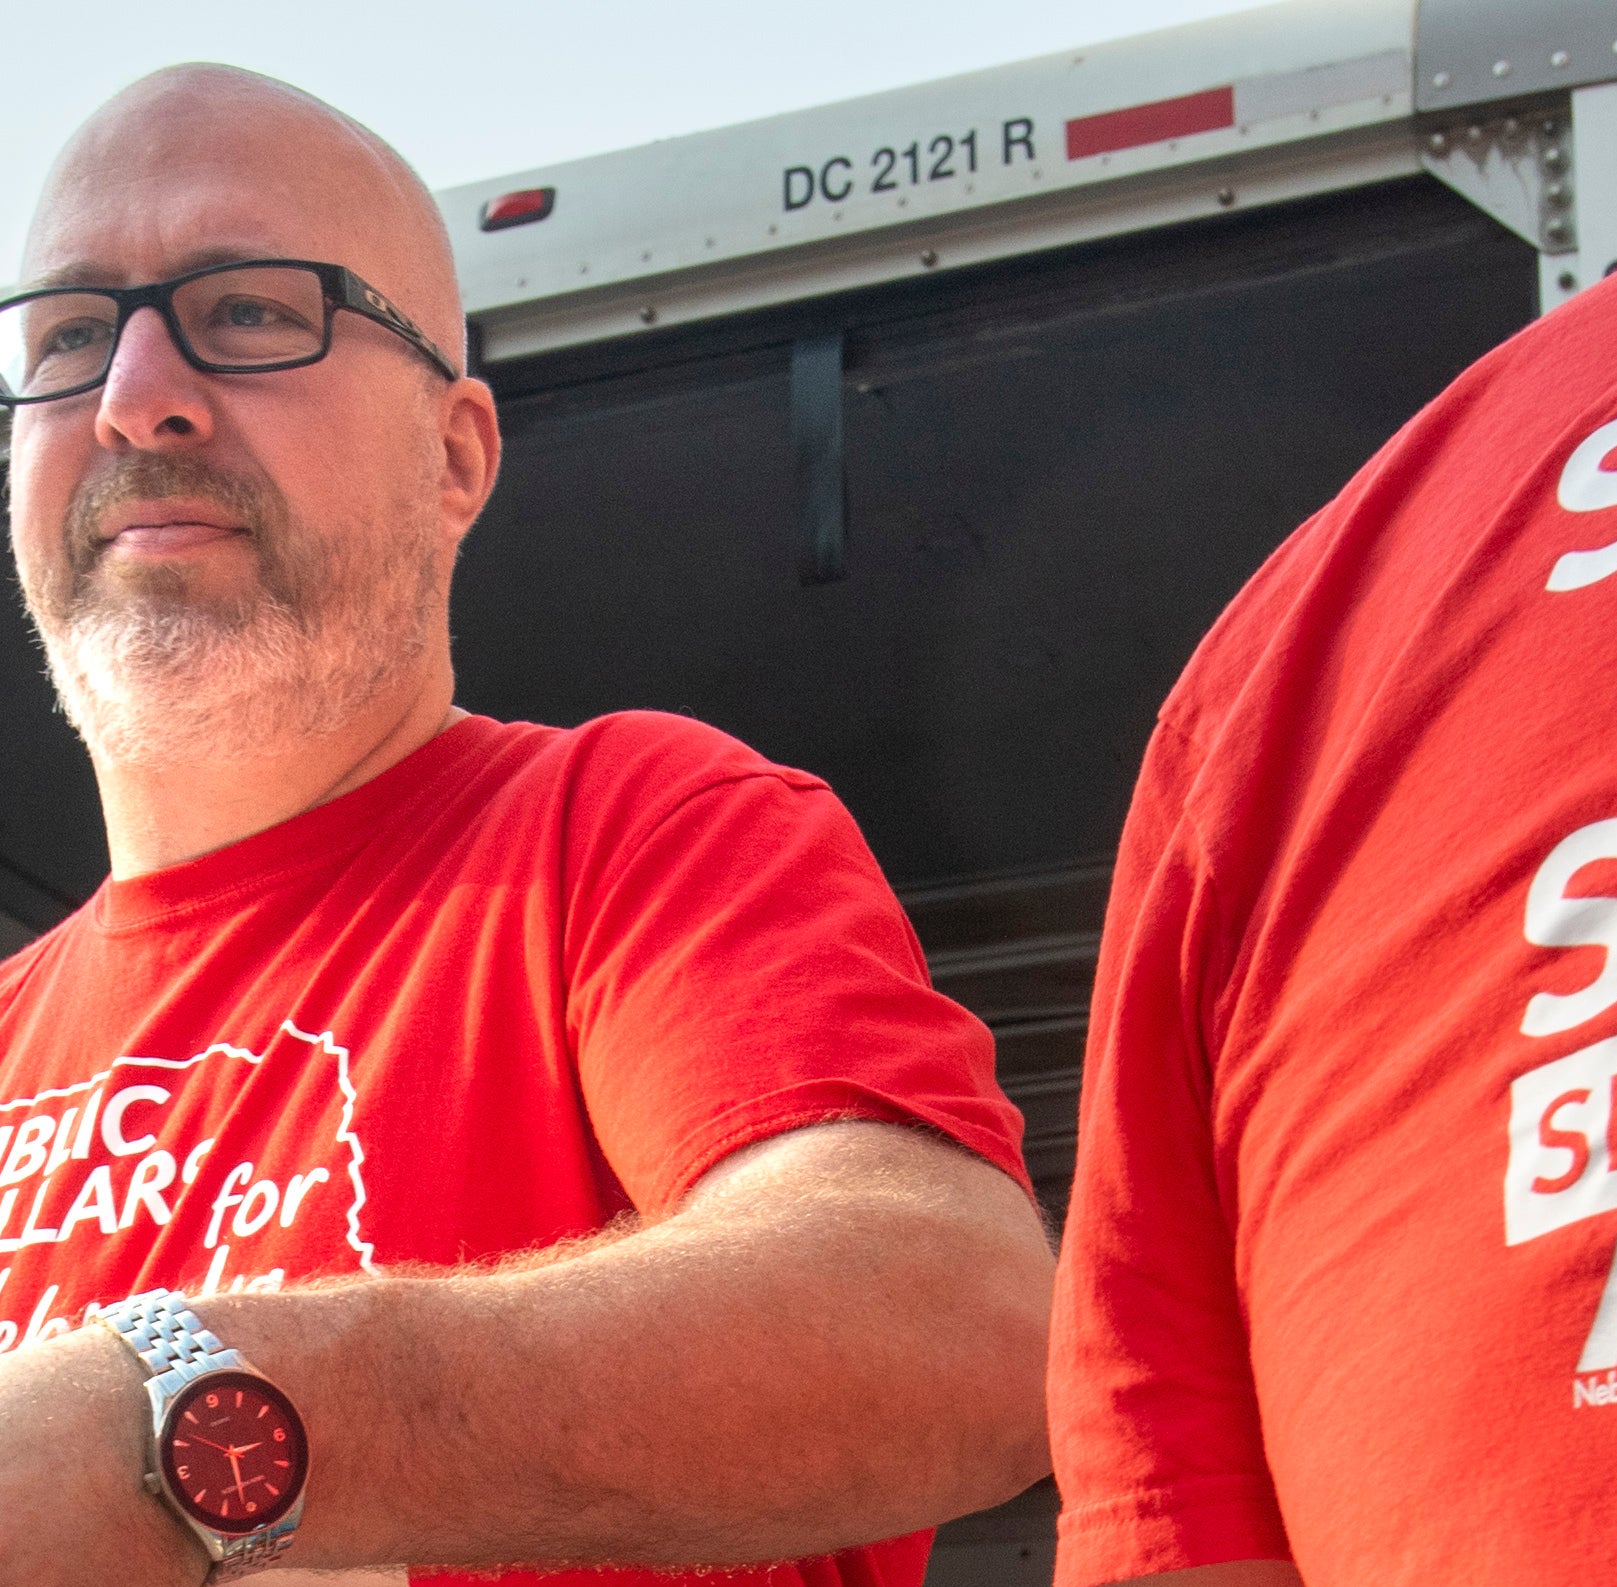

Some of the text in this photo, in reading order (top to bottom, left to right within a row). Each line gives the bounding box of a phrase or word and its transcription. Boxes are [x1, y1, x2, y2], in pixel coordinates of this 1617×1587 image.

[783, 117, 1035, 212] DC 2121 R
[205, 1162, 329, 1248] for
